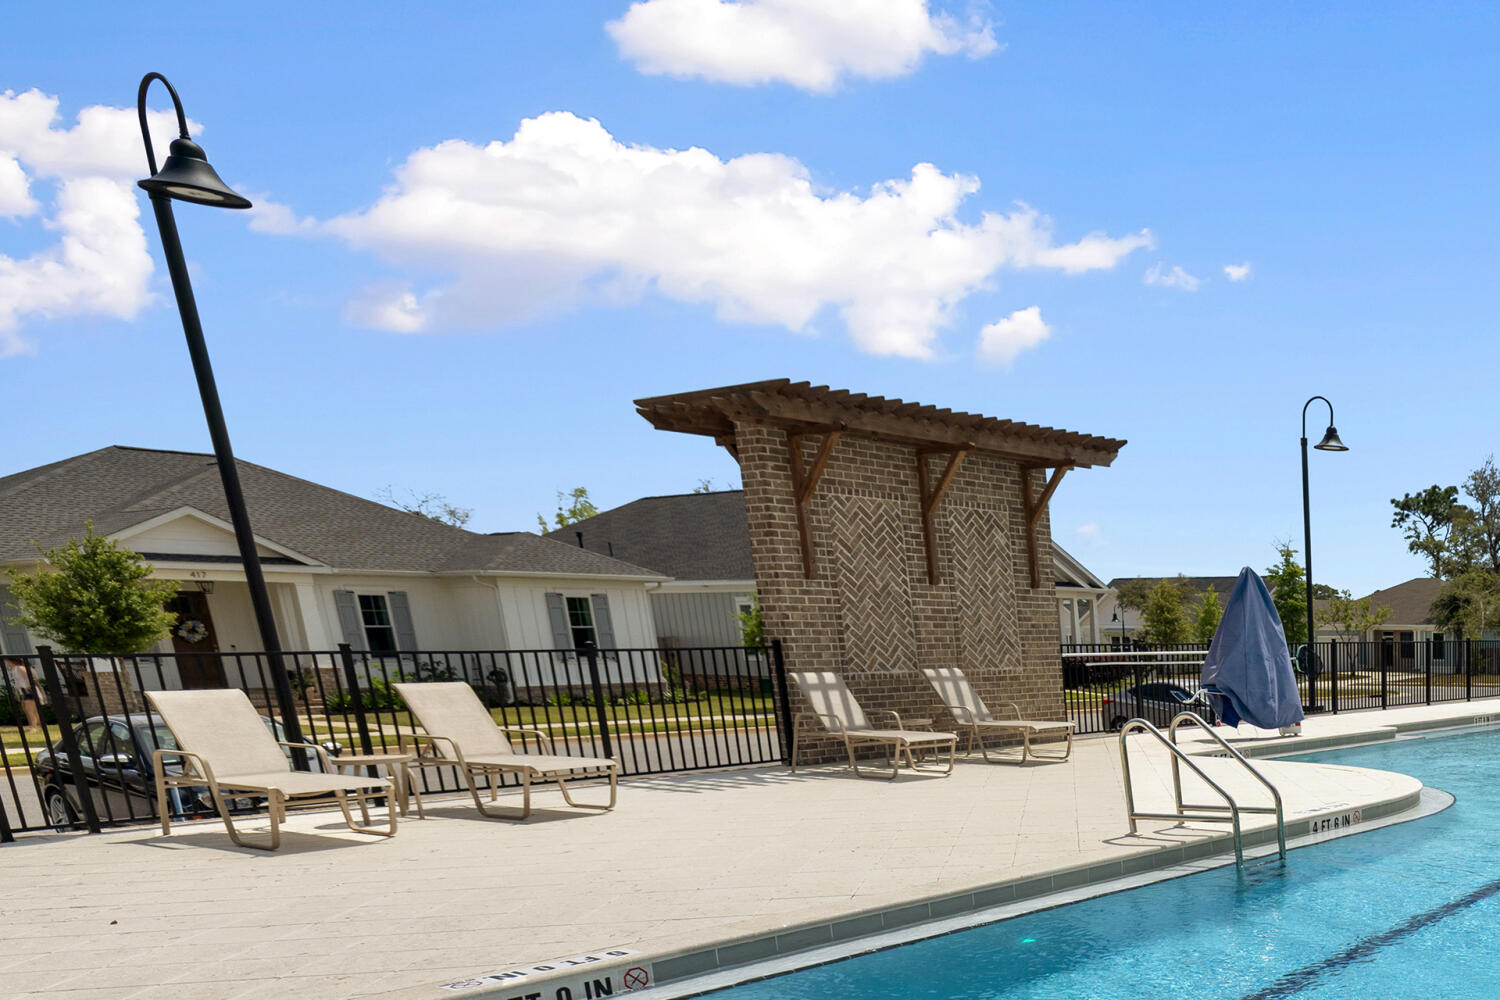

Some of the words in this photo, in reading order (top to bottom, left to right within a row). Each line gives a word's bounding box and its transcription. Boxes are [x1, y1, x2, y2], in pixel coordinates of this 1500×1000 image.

[1312, 821, 1318, 832] 4
[1321, 819, 1331, 831] FT
[1342, 814, 1350, 827] IN
[584, 977, 613, 1000] IN
